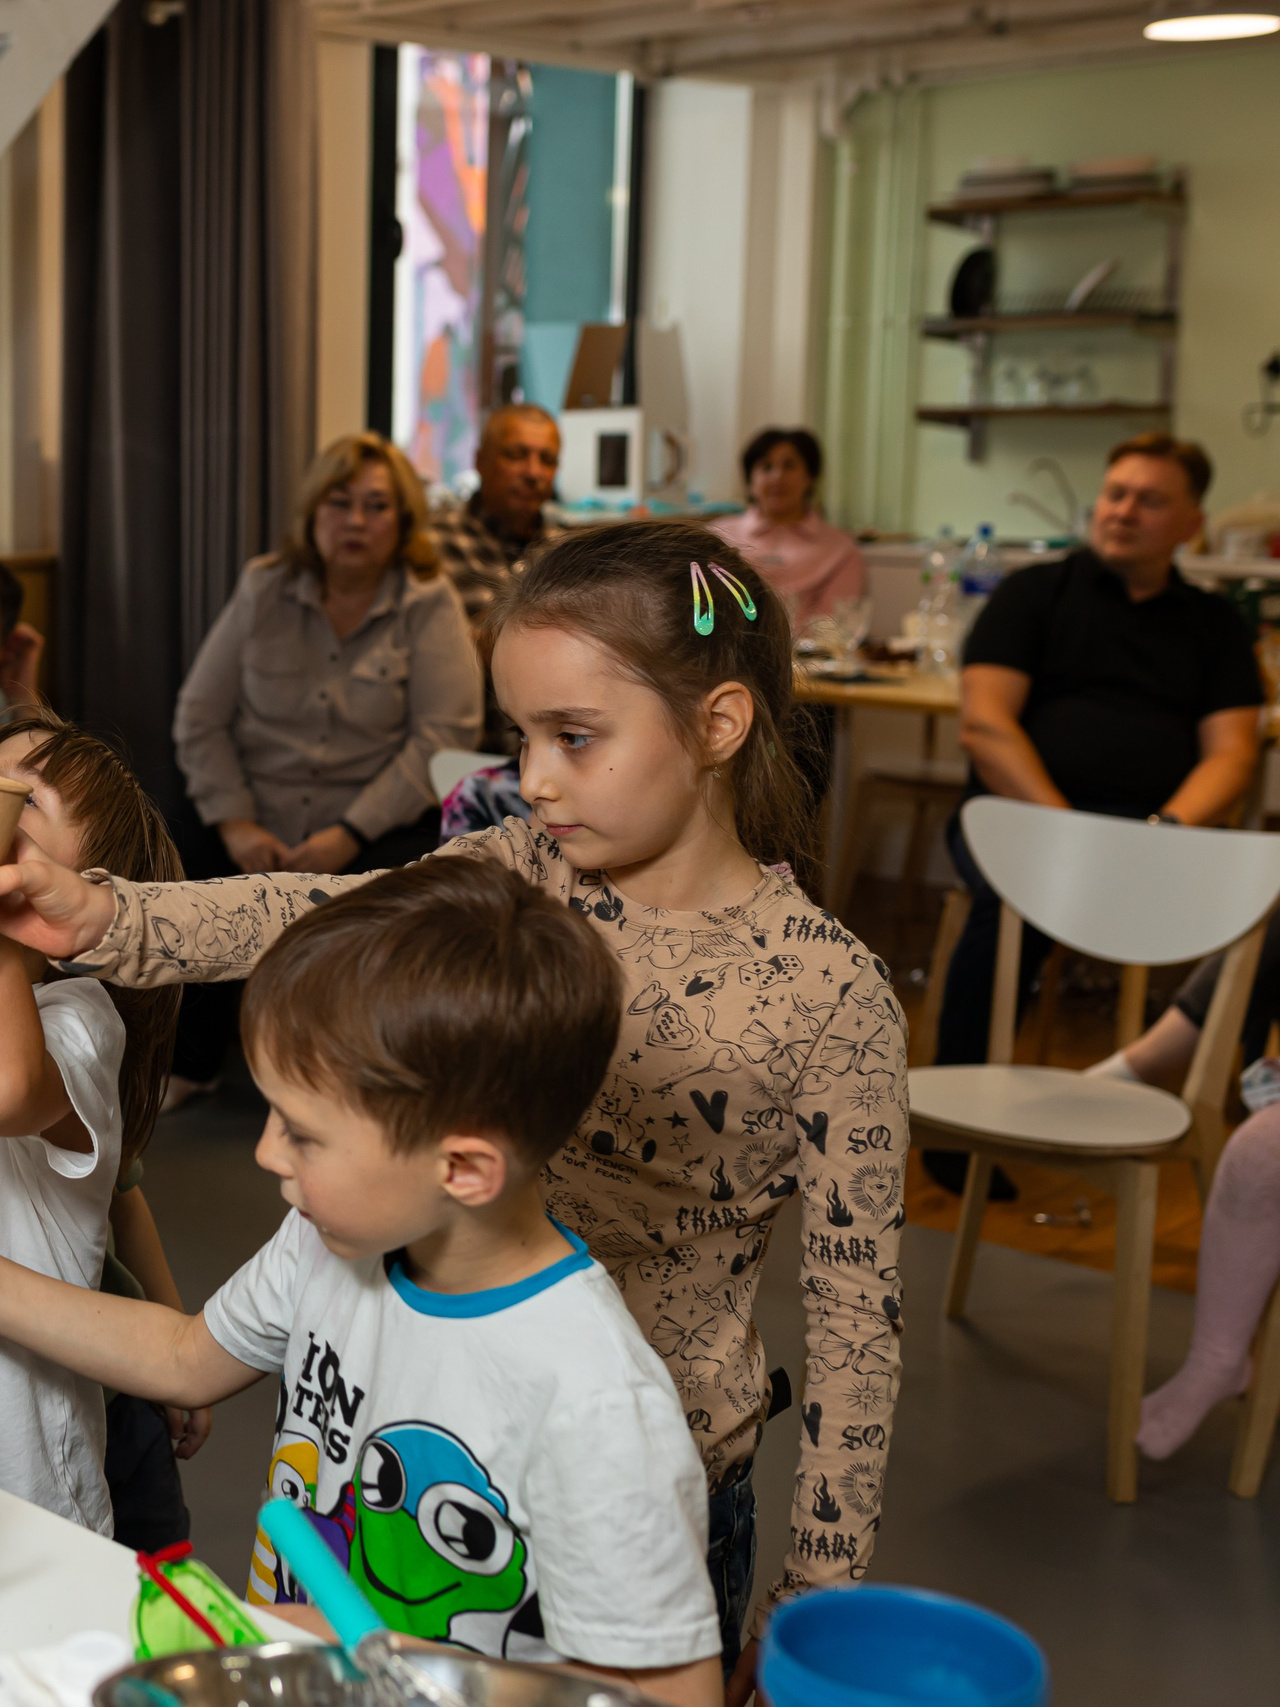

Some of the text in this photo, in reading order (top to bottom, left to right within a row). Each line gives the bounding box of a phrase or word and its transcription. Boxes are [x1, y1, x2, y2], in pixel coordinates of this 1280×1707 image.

[561, 1153, 632, 1185] YOUR FEARS
[584, 1152, 639, 1176] STRENGTH
[675, 1205, 750, 1236] CHAOS
[808, 1231, 879, 1270] CHAOS
[723, 1387, 746, 1415] ALWAYS
